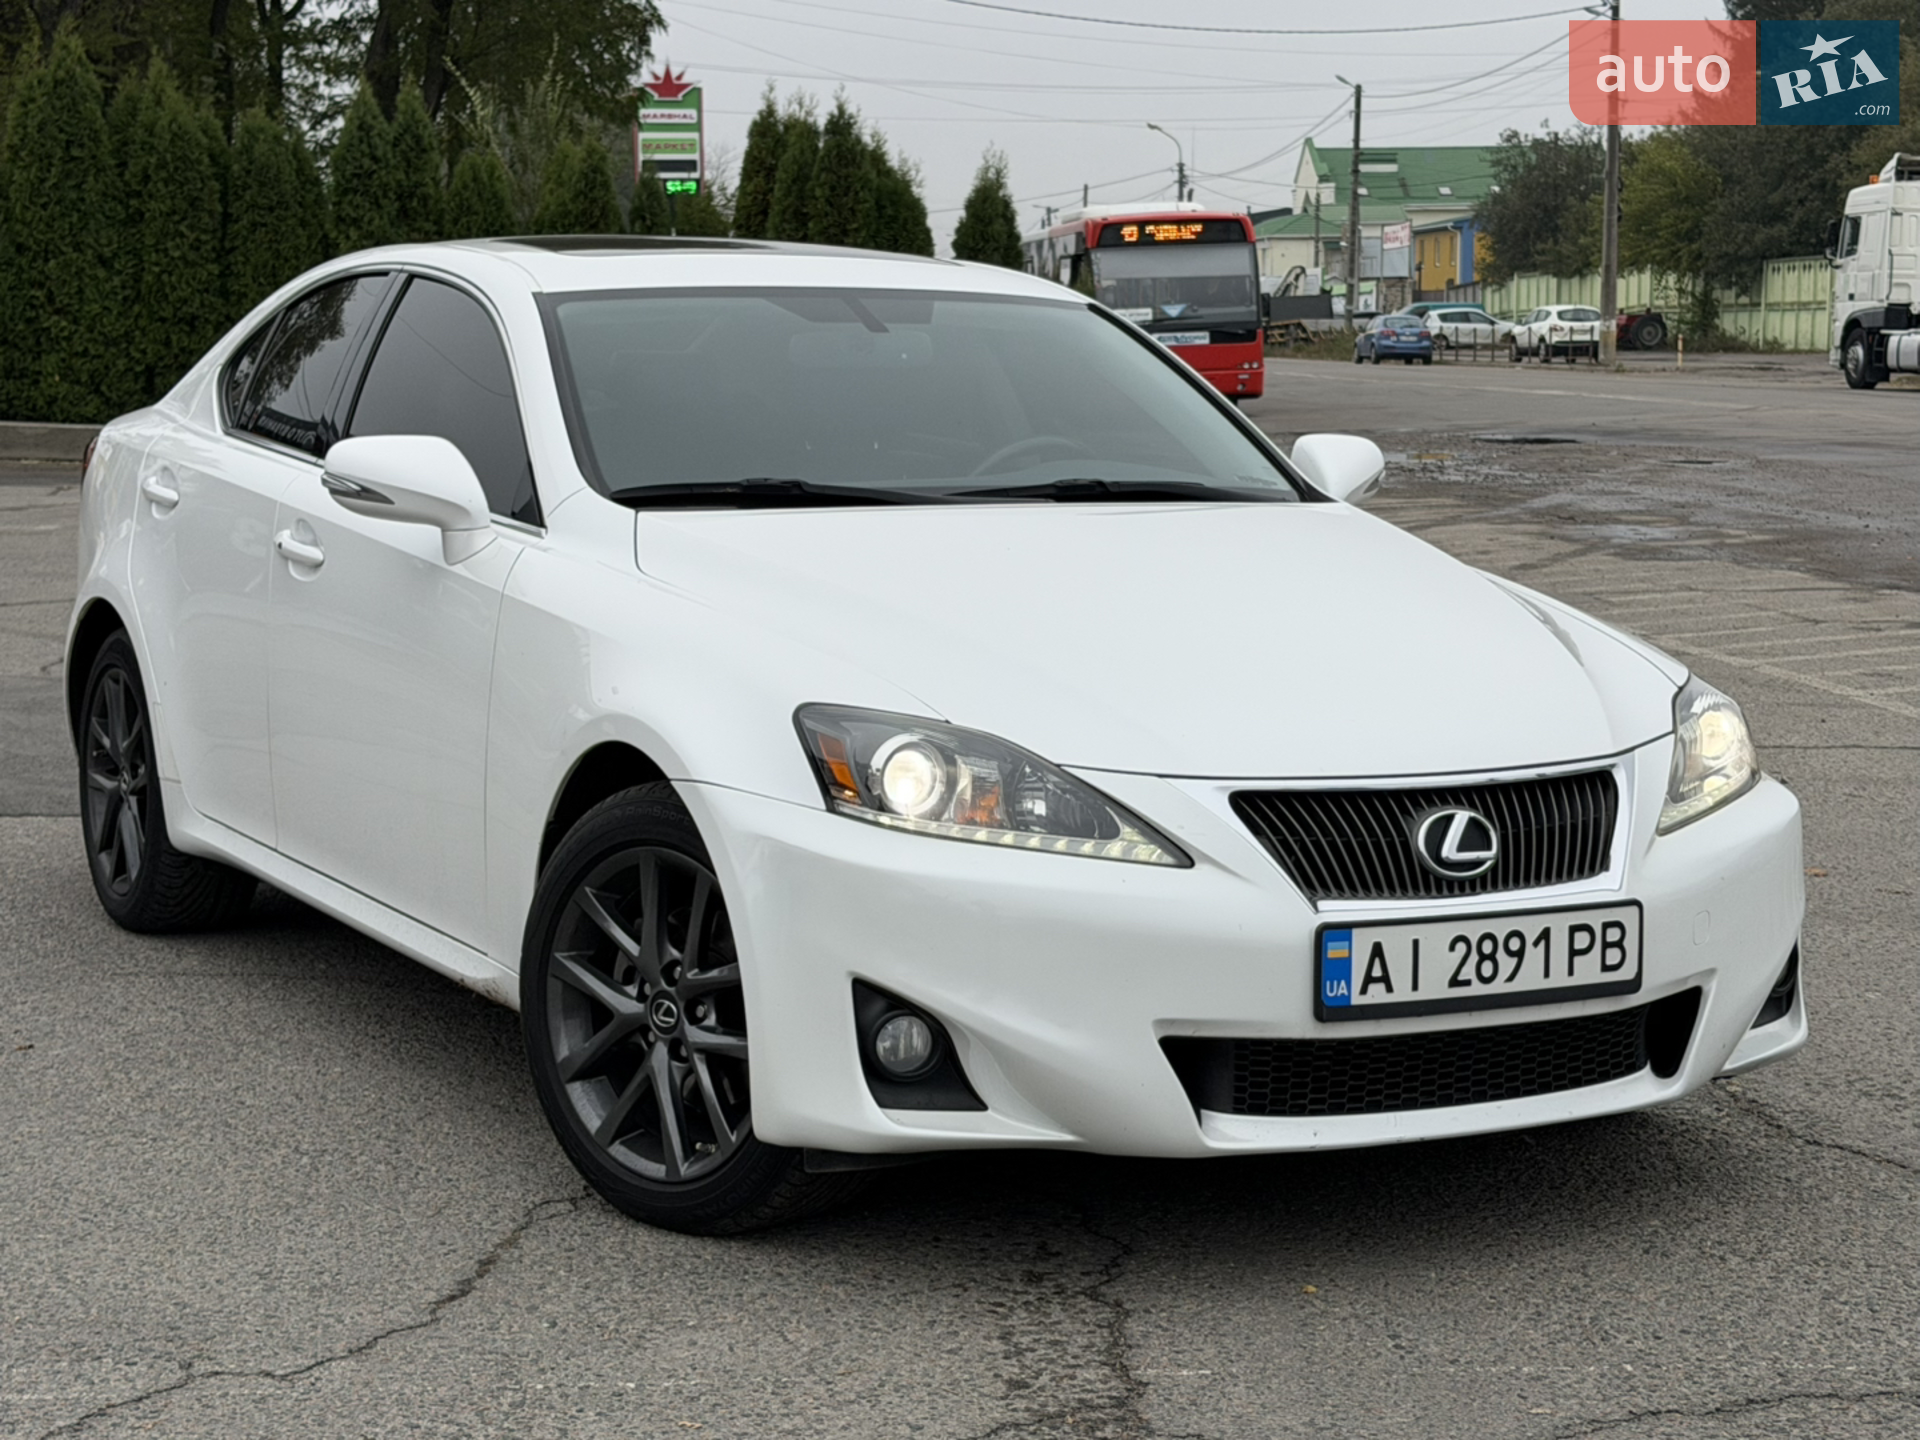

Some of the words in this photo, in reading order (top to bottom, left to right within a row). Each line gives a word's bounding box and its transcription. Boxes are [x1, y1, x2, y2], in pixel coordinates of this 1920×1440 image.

[641, 112, 695, 121] MARSHAL
[641, 142, 696, 151] MARKET
[1359, 938, 1420, 996] AI
[1447, 925, 1551, 989] 2891
[1566, 919, 1627, 977] PB
[1326, 979, 1349, 997] UA
